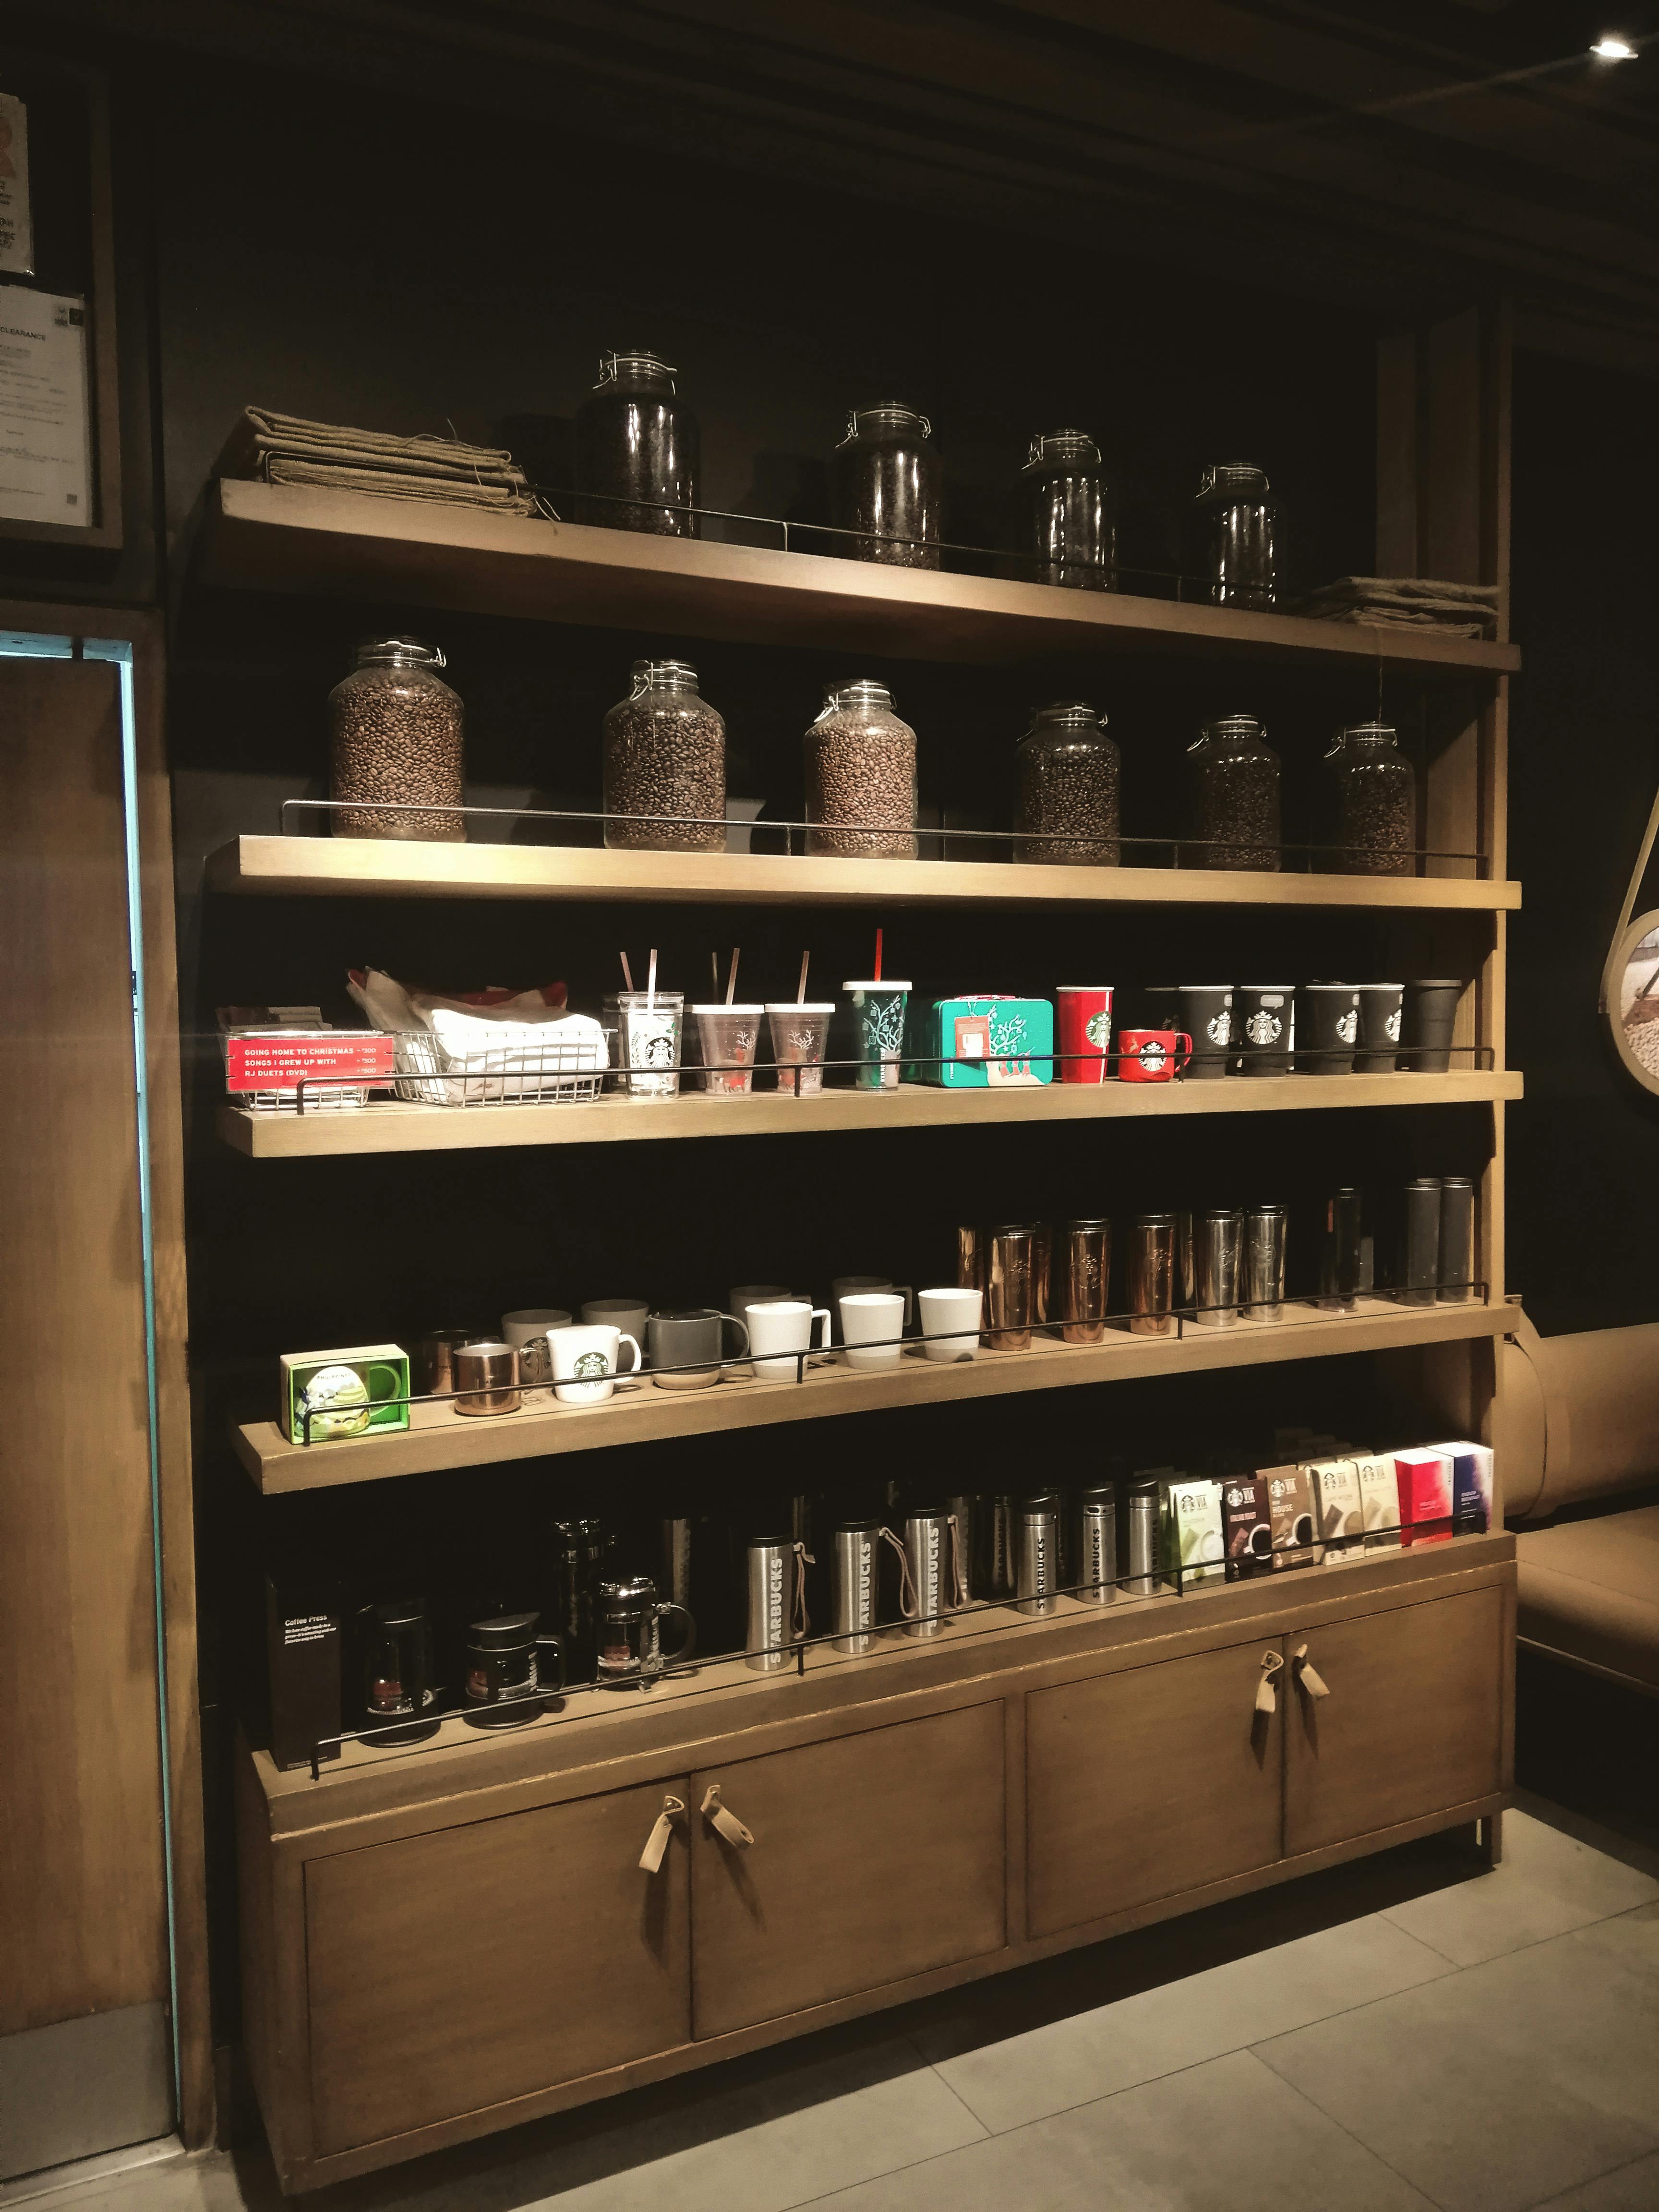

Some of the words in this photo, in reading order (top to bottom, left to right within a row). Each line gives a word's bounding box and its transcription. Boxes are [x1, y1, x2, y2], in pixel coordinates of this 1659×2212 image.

[0, 326, 46, 341] CLEARANCE
[285, 1618, 307, 1626] Coffee
[309, 1615, 327, 1623] Press
